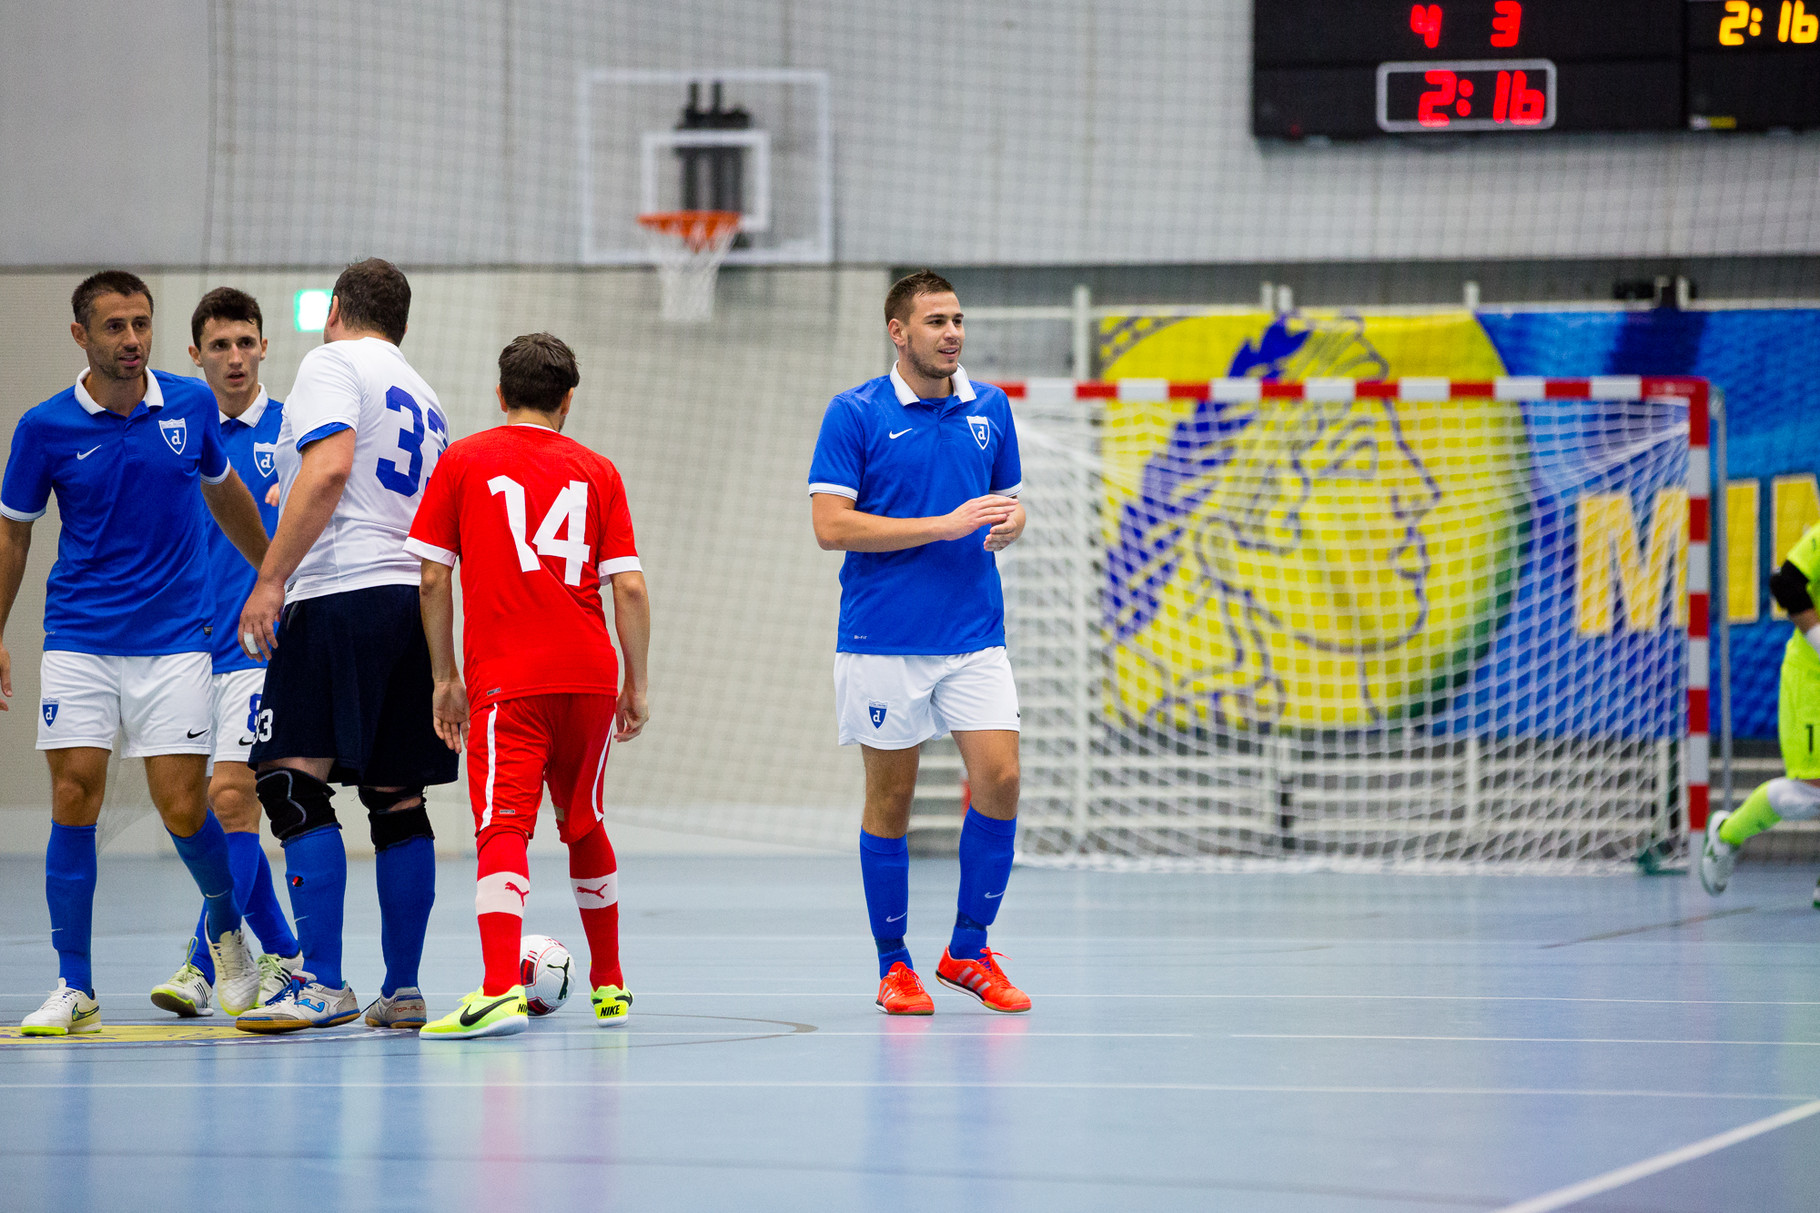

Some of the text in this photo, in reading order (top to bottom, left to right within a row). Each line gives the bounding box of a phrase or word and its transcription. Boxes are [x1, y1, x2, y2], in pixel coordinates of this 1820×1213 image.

[1410, 4, 1443, 48] 4
[1490, 0, 1522, 48] 3
[1719, 0, 1819, 46] 2:16
[1418, 69, 1545, 127] 2:16
[171, 429, 182, 445] d
[977, 425, 986, 440] d
[260, 453, 271, 468] d
[487, 474, 590, 587] 14
[600, 1004, 621, 1017] NIKE
